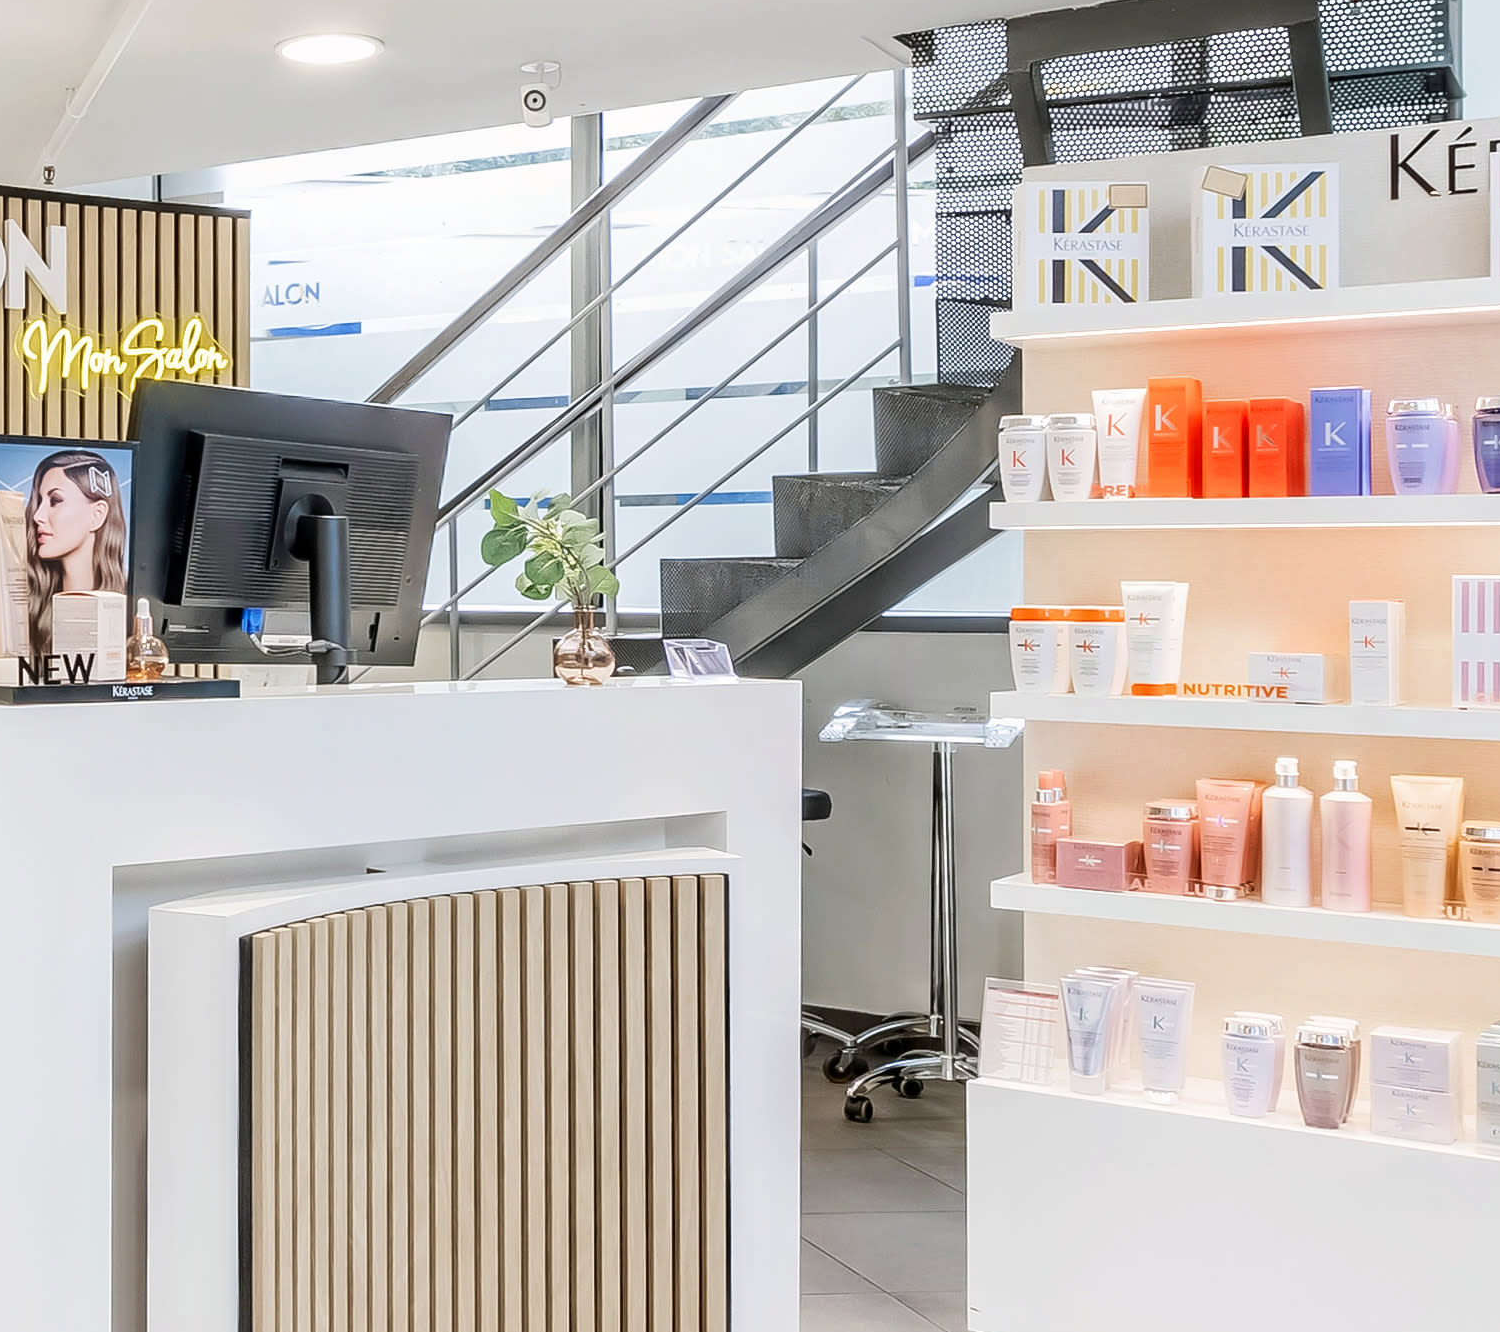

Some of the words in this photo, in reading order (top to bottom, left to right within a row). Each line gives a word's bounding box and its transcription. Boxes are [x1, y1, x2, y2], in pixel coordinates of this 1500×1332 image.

[1233, 221, 1310, 240] KÉRASTASE
[1053, 236, 1123, 252] KÉRASTASE
[22, 319, 126, 396] Mon
[122, 315, 230, 387] Salon
[18, 652, 95, 685] NEW
[1183, 683, 1287, 700] NUTRITIVE
